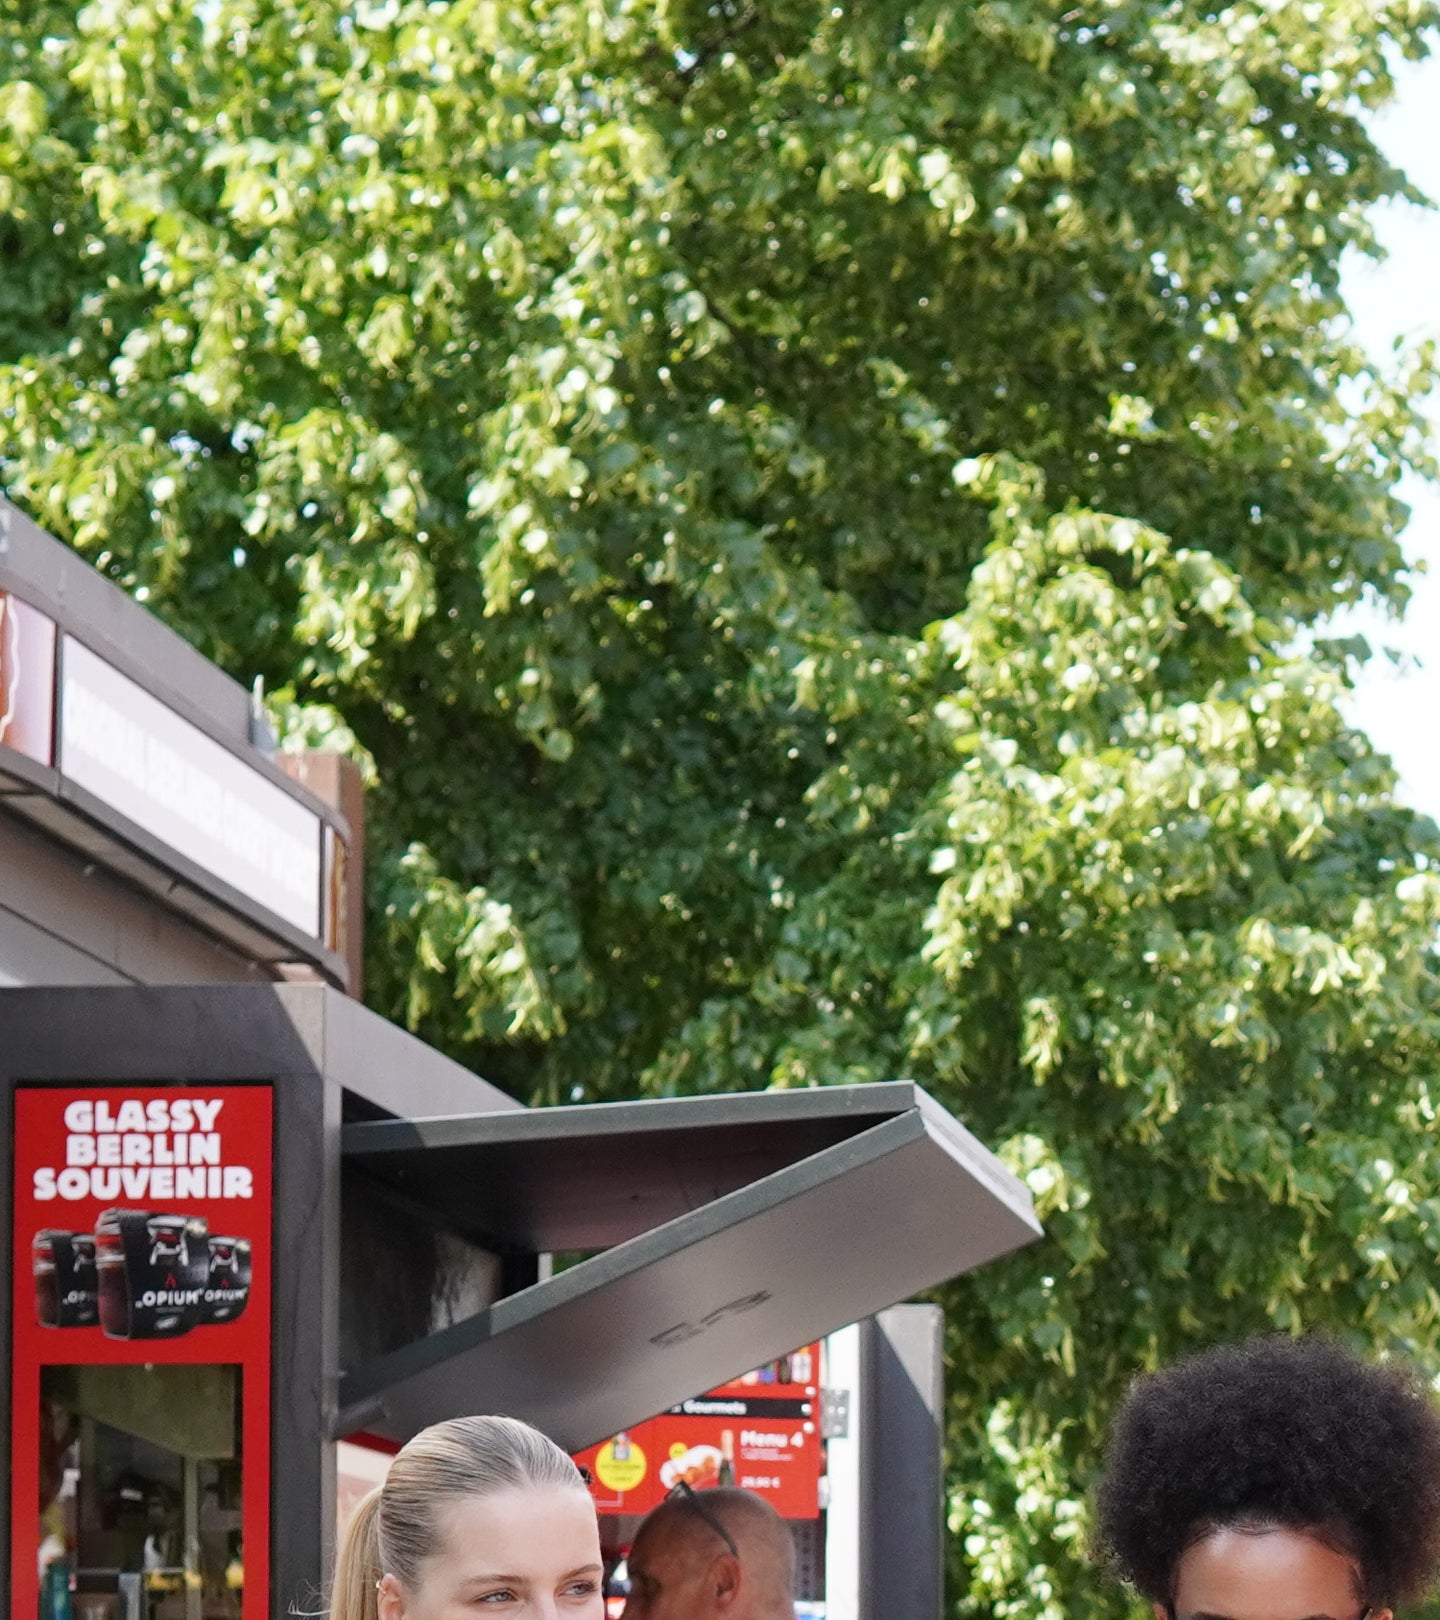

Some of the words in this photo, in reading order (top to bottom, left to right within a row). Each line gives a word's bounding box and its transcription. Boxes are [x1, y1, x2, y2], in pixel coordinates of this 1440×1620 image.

[64, 1099, 224, 1133] GLASSY
[66, 1133, 221, 1166] BERLIN
[33, 1166, 253, 1200] SOUVENIR
[740, 1430, 789, 1448] Menu
[790, 1431, 804, 1449] 4
